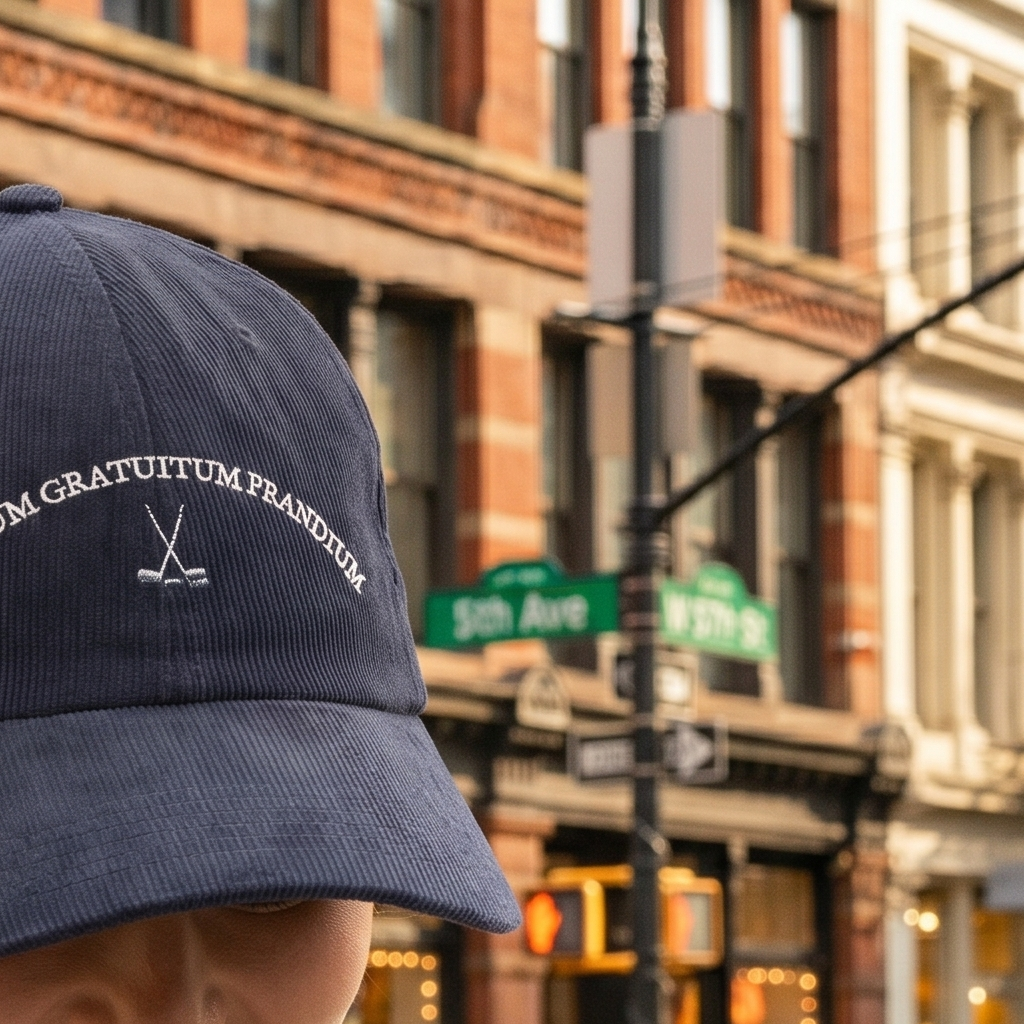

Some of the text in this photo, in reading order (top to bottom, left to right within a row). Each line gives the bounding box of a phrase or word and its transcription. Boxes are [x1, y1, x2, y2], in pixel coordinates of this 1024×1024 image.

[39, 455, 245, 504] GRATUITUM
[245, 470, 368, 595] PRANDIUM
[519, 590, 589, 634] Ave
